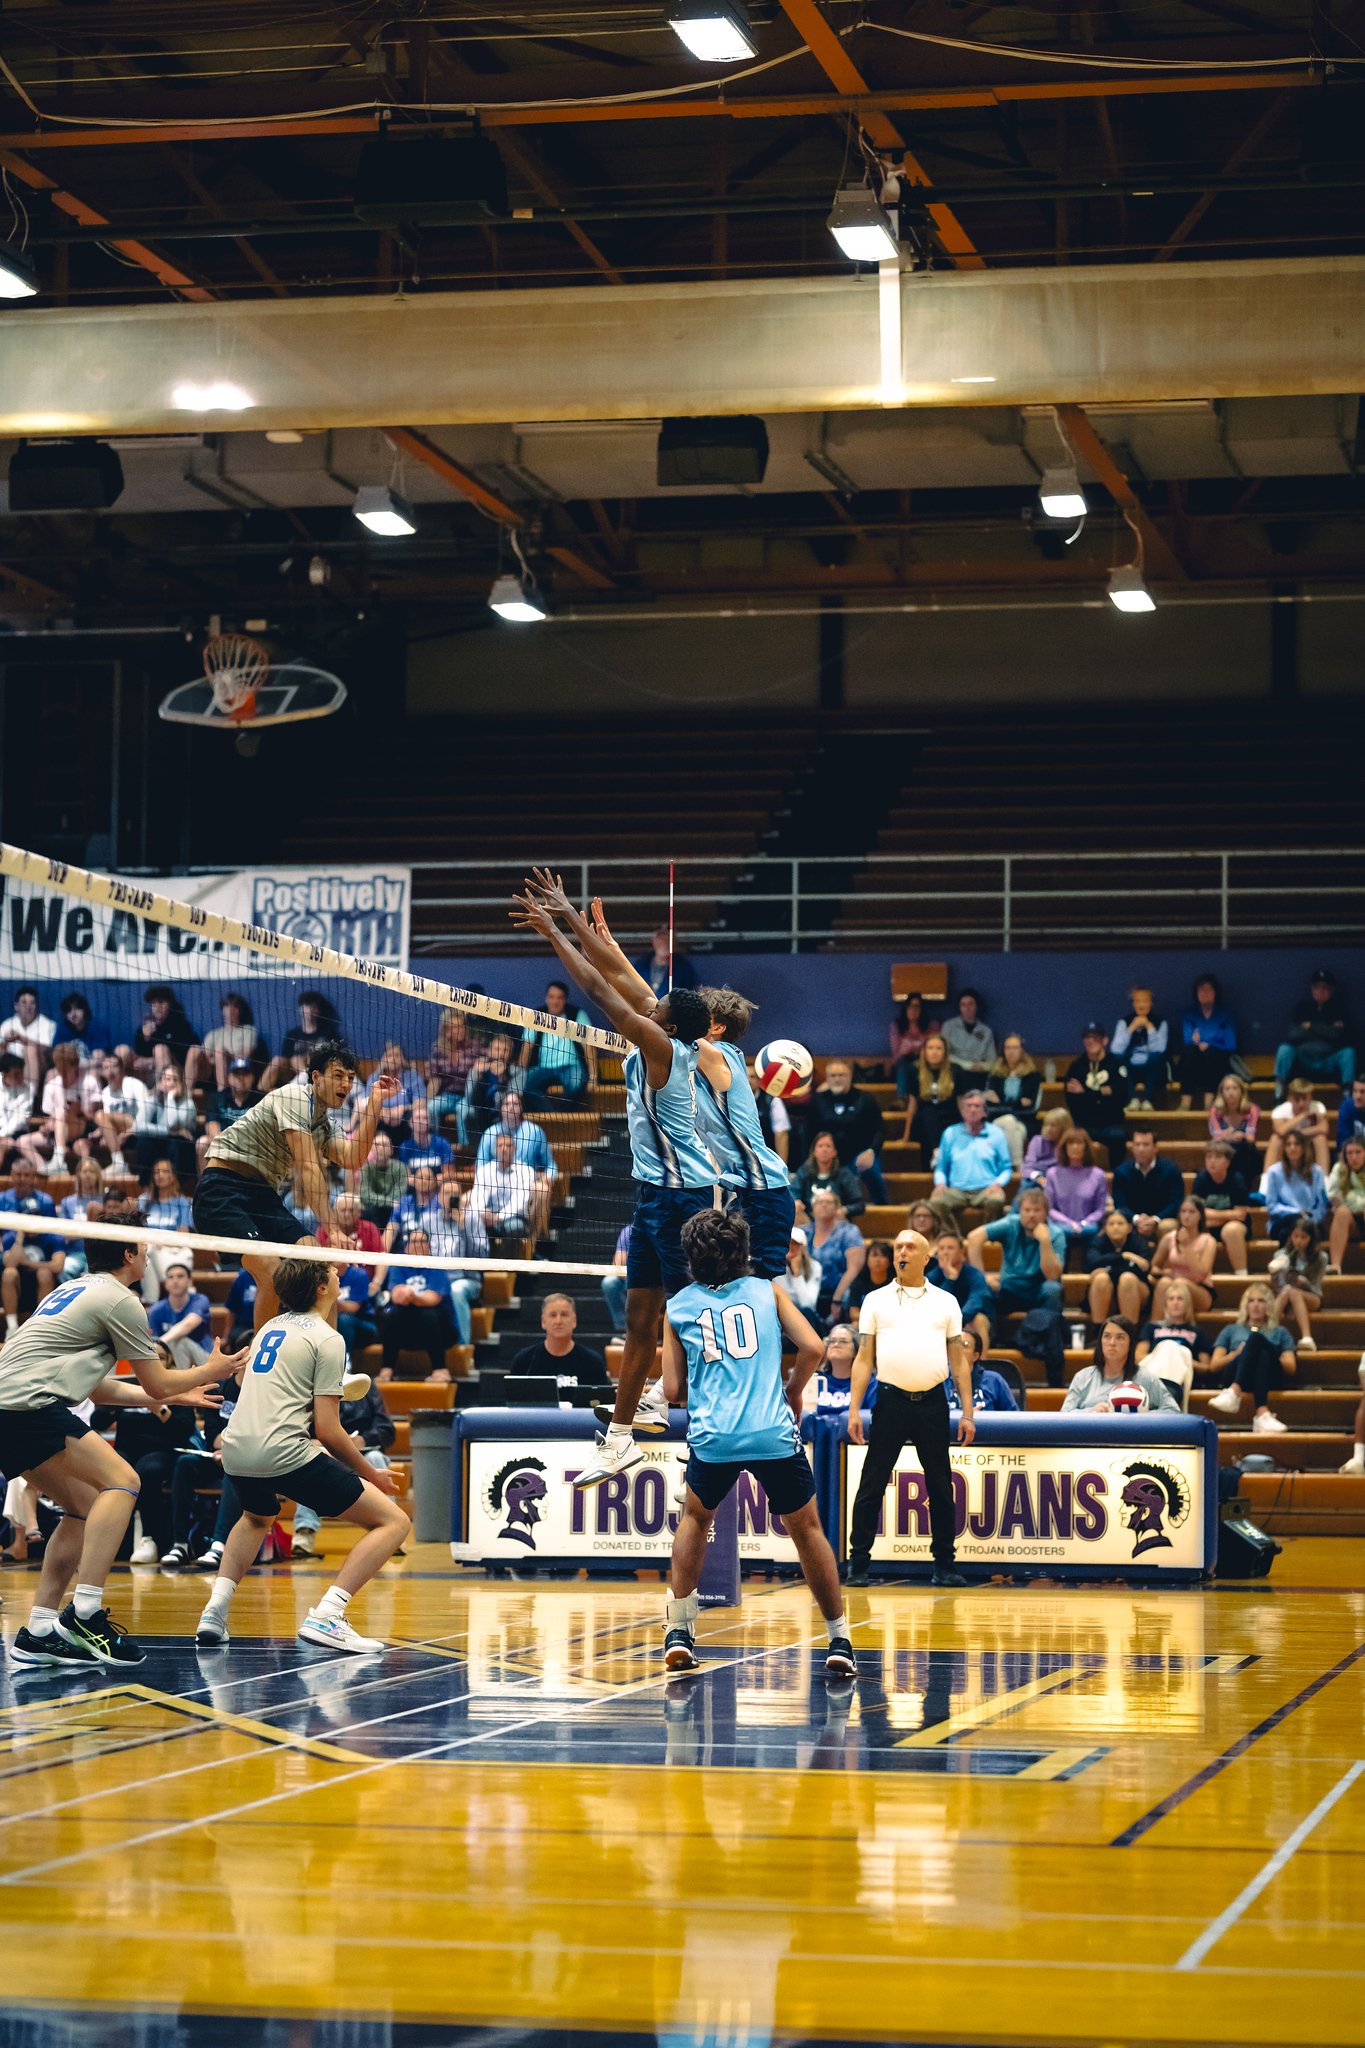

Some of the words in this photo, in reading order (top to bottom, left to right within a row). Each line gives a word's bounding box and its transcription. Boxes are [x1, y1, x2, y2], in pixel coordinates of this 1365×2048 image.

[252, 876, 406, 914] Positively
[11, 897, 94, 955] We
[31, 1285, 87, 1317] 19
[695, 1302, 760, 1364] 10
[251, 1329, 287, 1374] 8
[642, 1451, 671, 1463] OME
[951, 1454, 972, 1466] ME
[976, 1454, 996, 1466] OF
[999, 1454, 1027, 1466] THE
[593, 1541, 642, 1551] DONATED
[644, 1541, 659, 1551] BY
[893, 1544, 929, 1554] DONAT
[963, 1545, 1005, 1555] TROJAN
[1007, 1546, 1066, 1556] BOOSTERS
